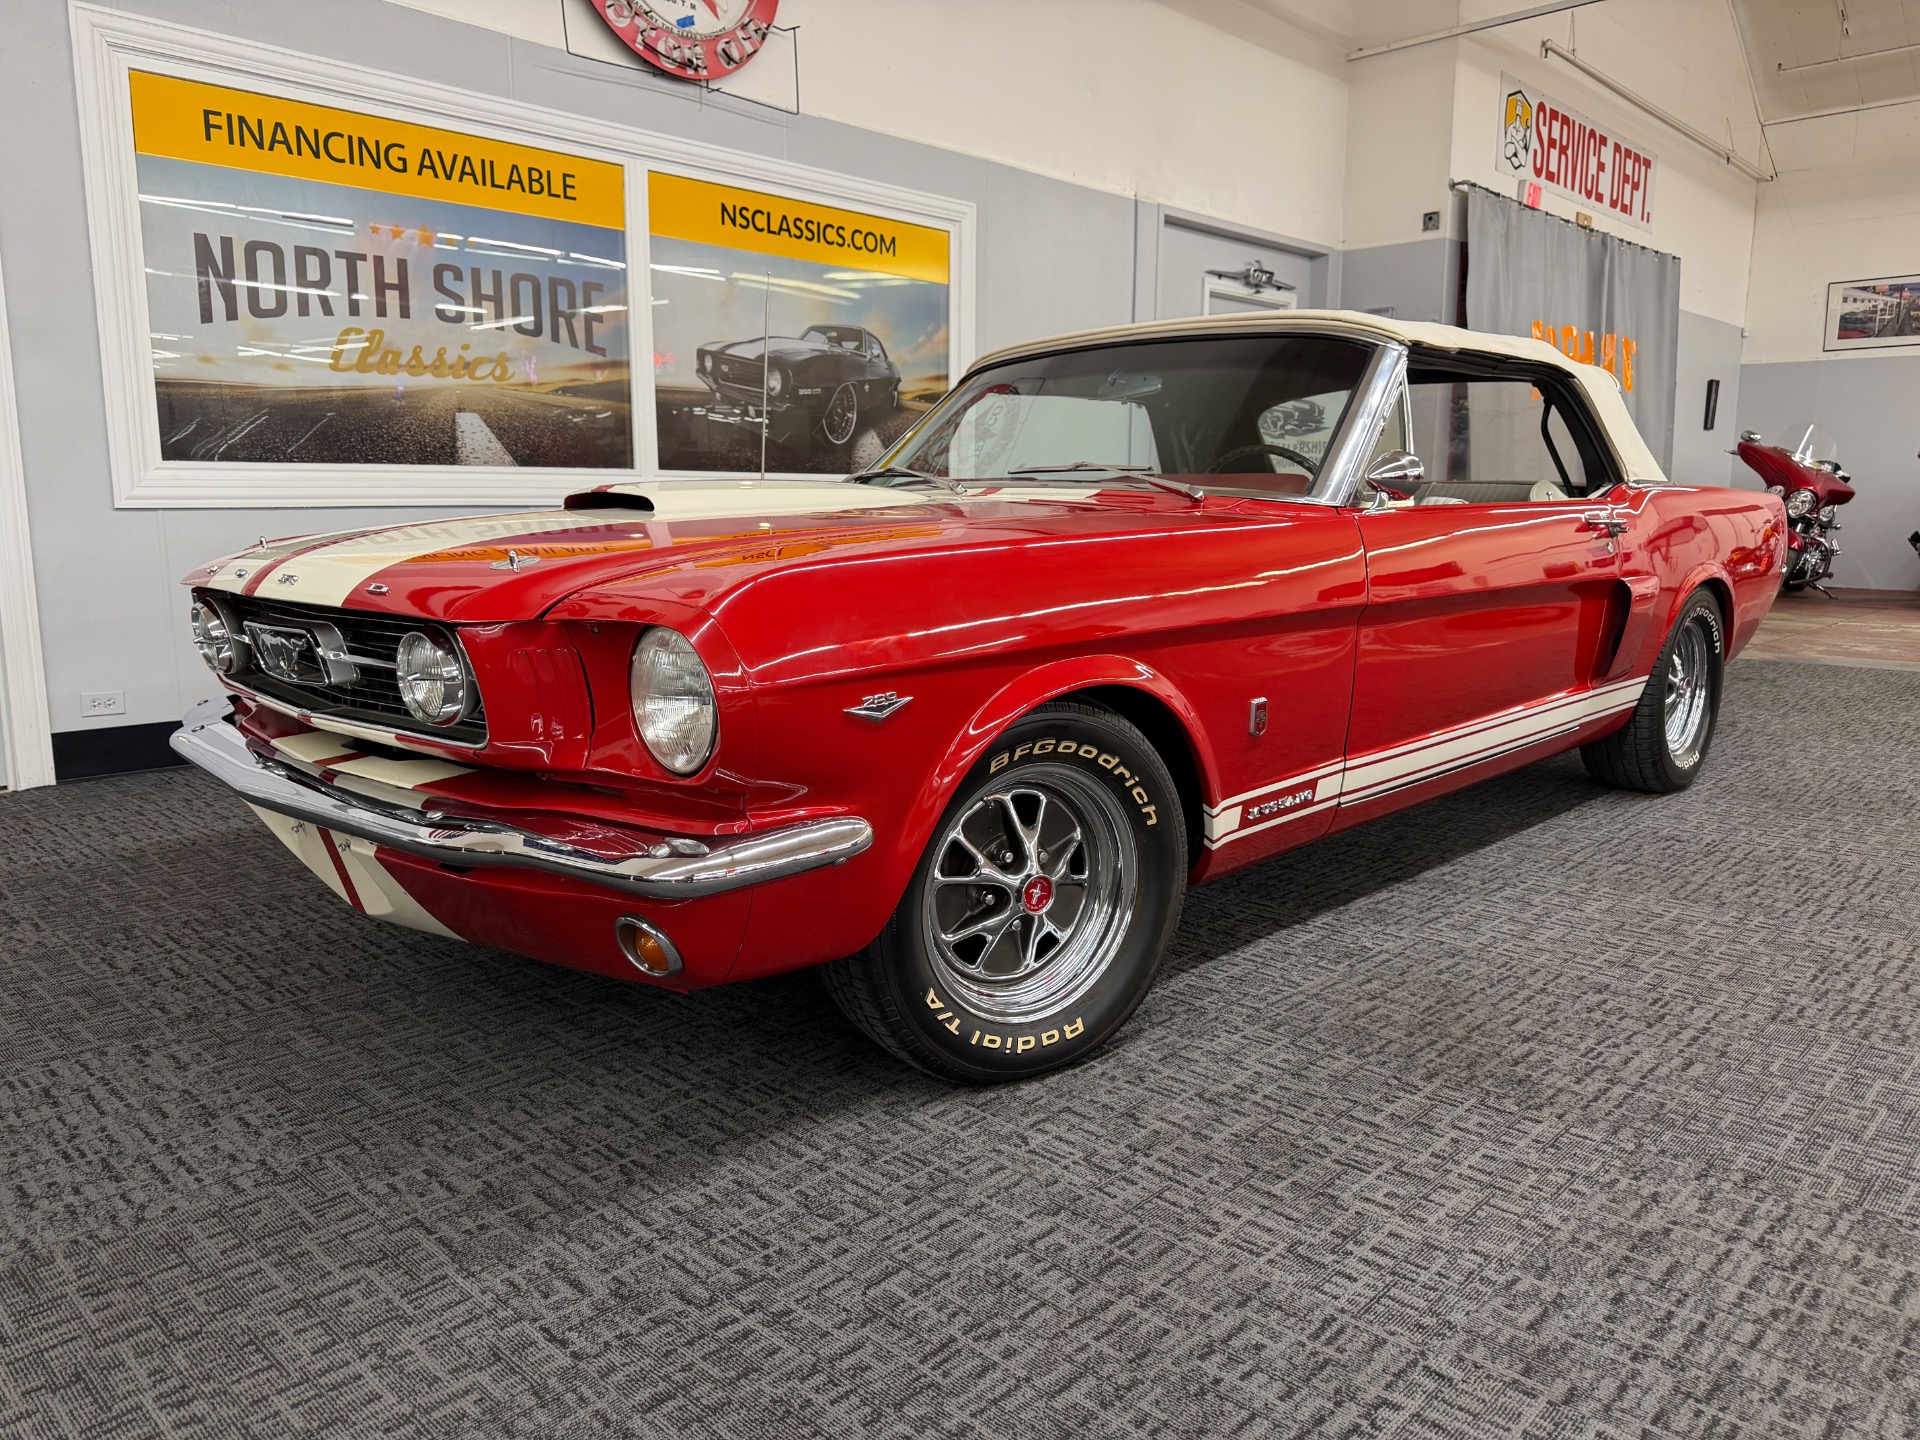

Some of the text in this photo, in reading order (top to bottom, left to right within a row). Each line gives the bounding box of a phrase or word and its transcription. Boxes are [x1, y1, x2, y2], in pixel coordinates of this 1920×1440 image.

[605, 0, 709, 76] OTOR
[202, 109, 577, 201] FINANCING AVAILABLE
[1533, 101, 1652, 223] SERVICE DEPT.
[721, 202, 896, 257] NSCLASSICS.COM
[193, 232, 607, 357] NORTH SHORE
[328, 327, 516, 382] Classics
[989, 739, 1159, 826] BFGoodrich
[924, 986, 1085, 1054] Radial T/A
